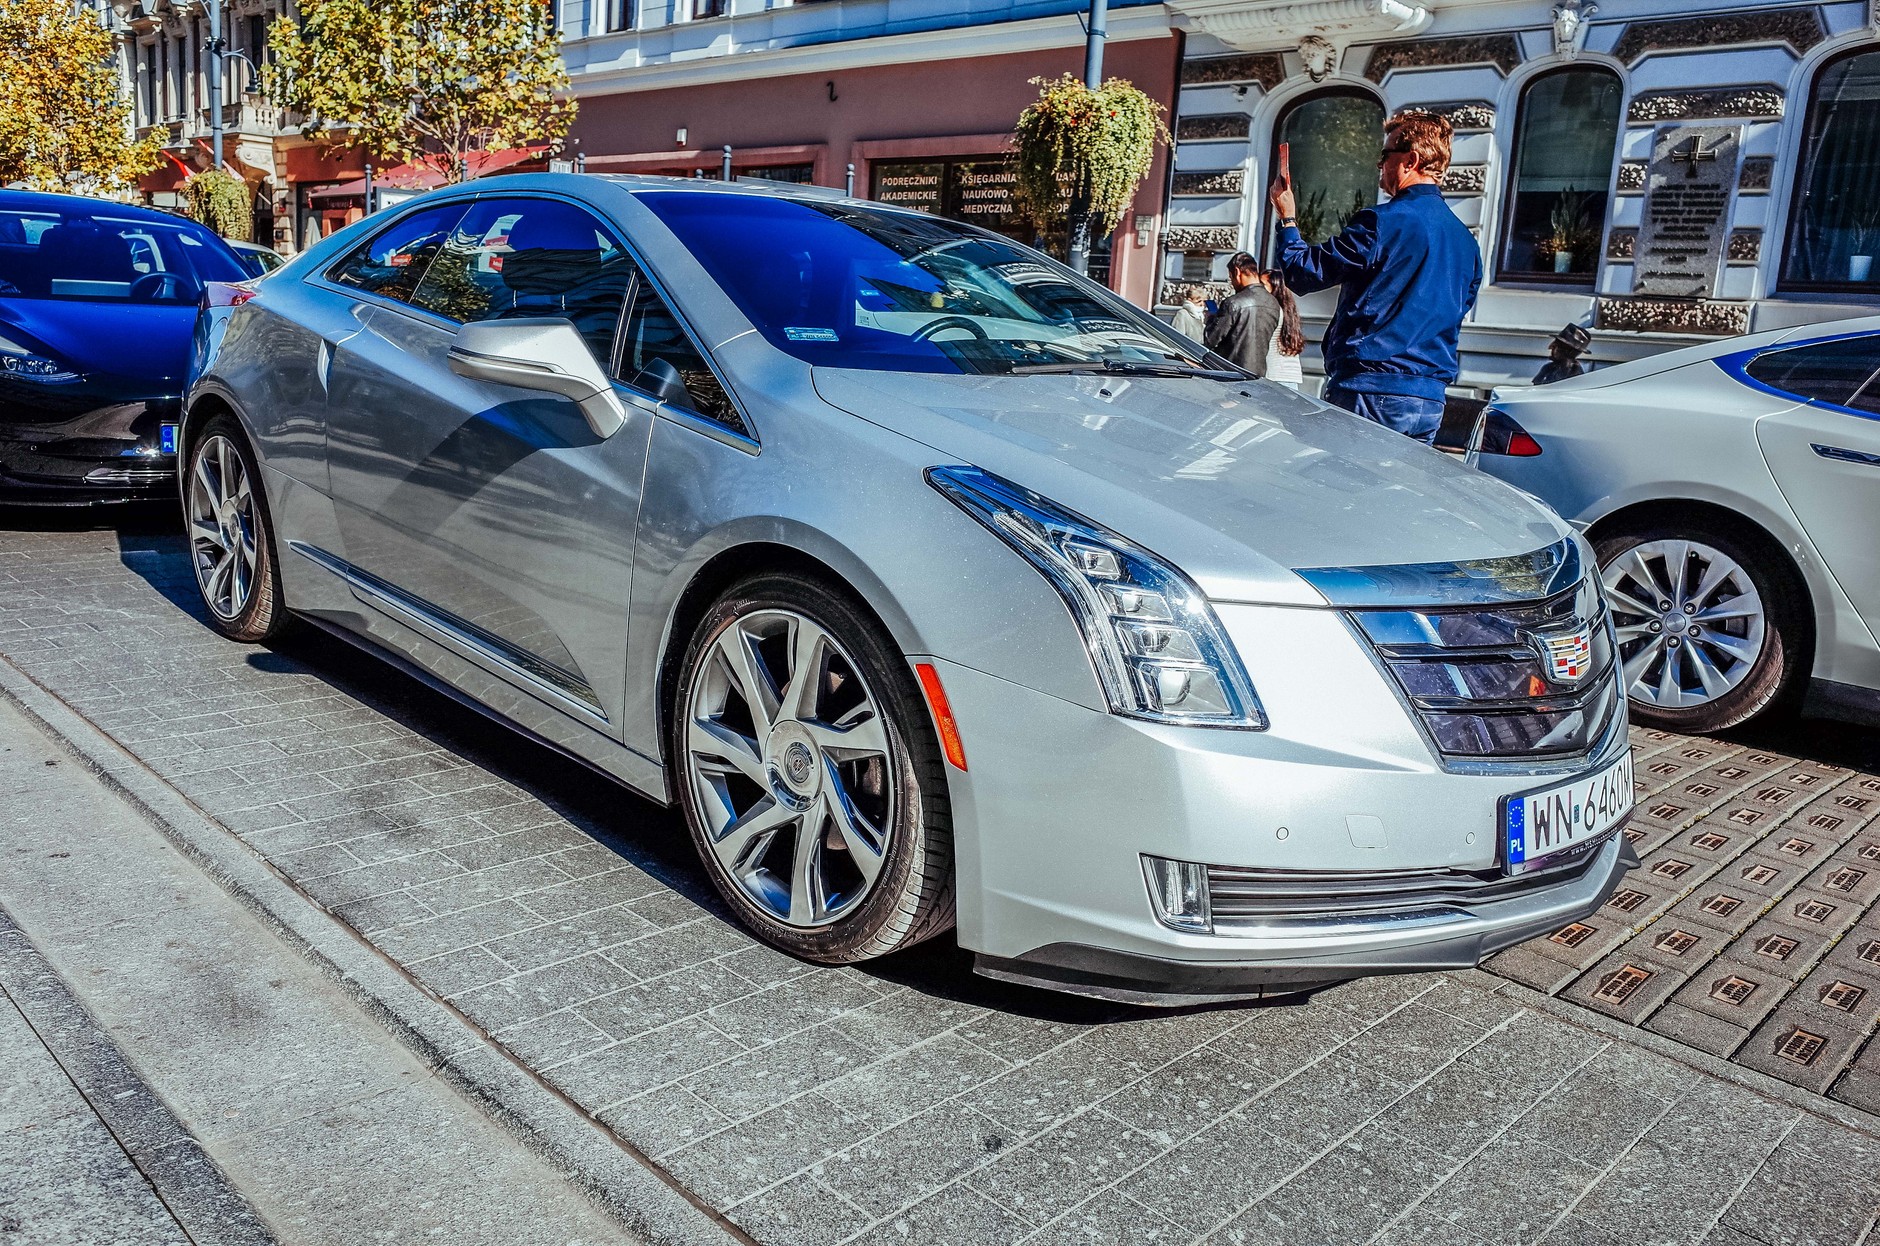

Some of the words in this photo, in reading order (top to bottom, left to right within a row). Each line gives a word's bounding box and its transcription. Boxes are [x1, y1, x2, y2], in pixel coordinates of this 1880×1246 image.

[882, 176, 938, 188] PODRĘCZNIKI
[961, 174, 1017, 186] KSIĘGARNIA
[880, 191, 938, 201] AKADEMICKIE
[962, 189, 1009, 199] NAUKOWO
[1532, 789, 1573, 851] WN
[1584, 756, 1632, 832] 6460M
[1510, 838, 1523, 854] PL
